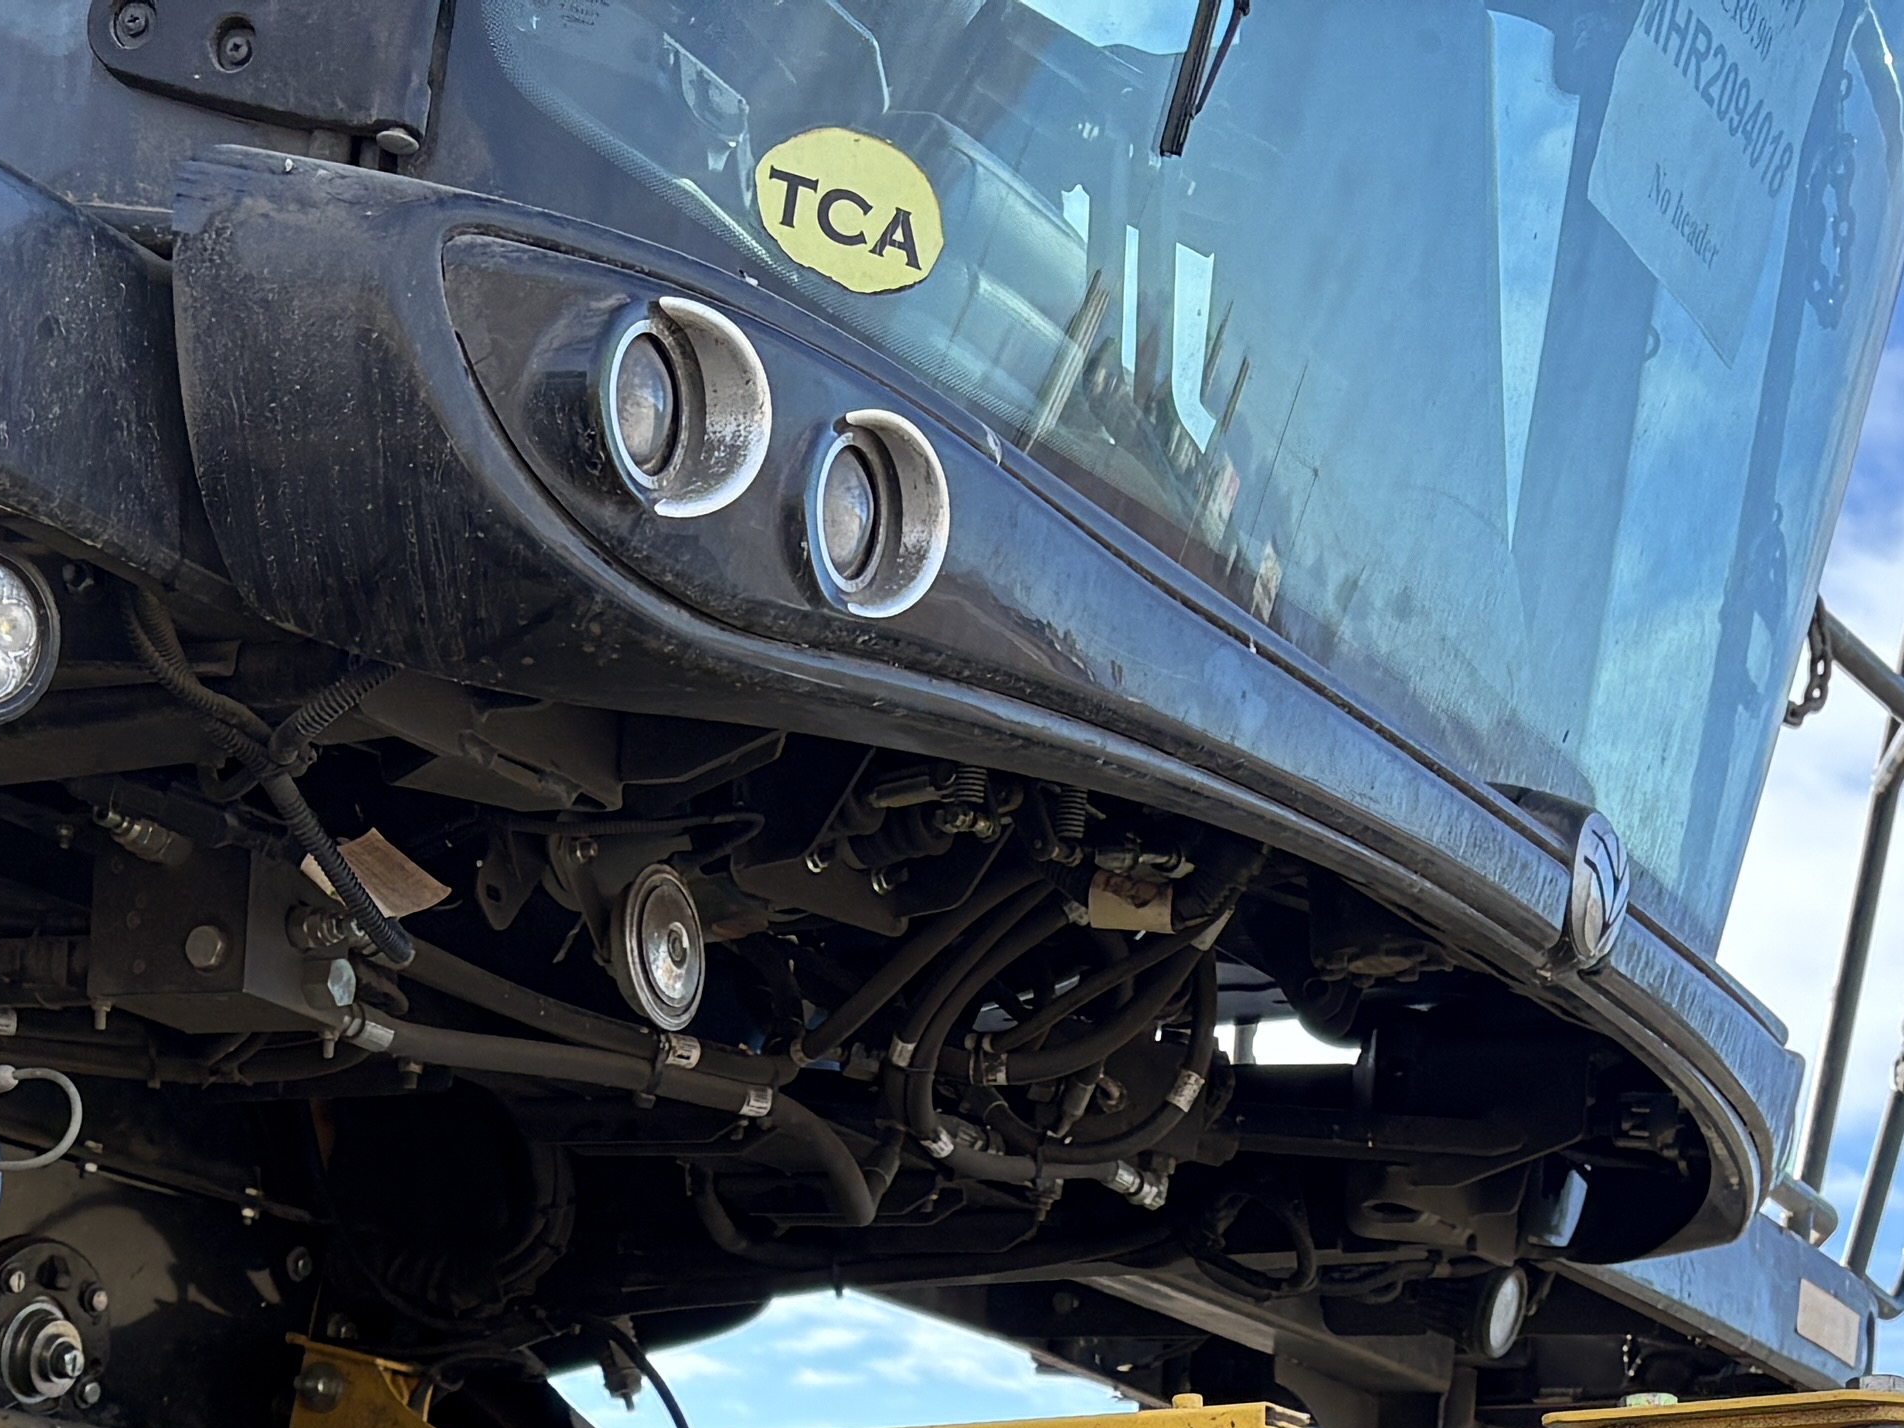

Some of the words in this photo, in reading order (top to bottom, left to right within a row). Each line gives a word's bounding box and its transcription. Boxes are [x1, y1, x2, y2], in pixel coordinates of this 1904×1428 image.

[769, 164, 922, 271] TCA
[1647, 161, 1671, 215] No
[1670, 189, 1720, 270] header
